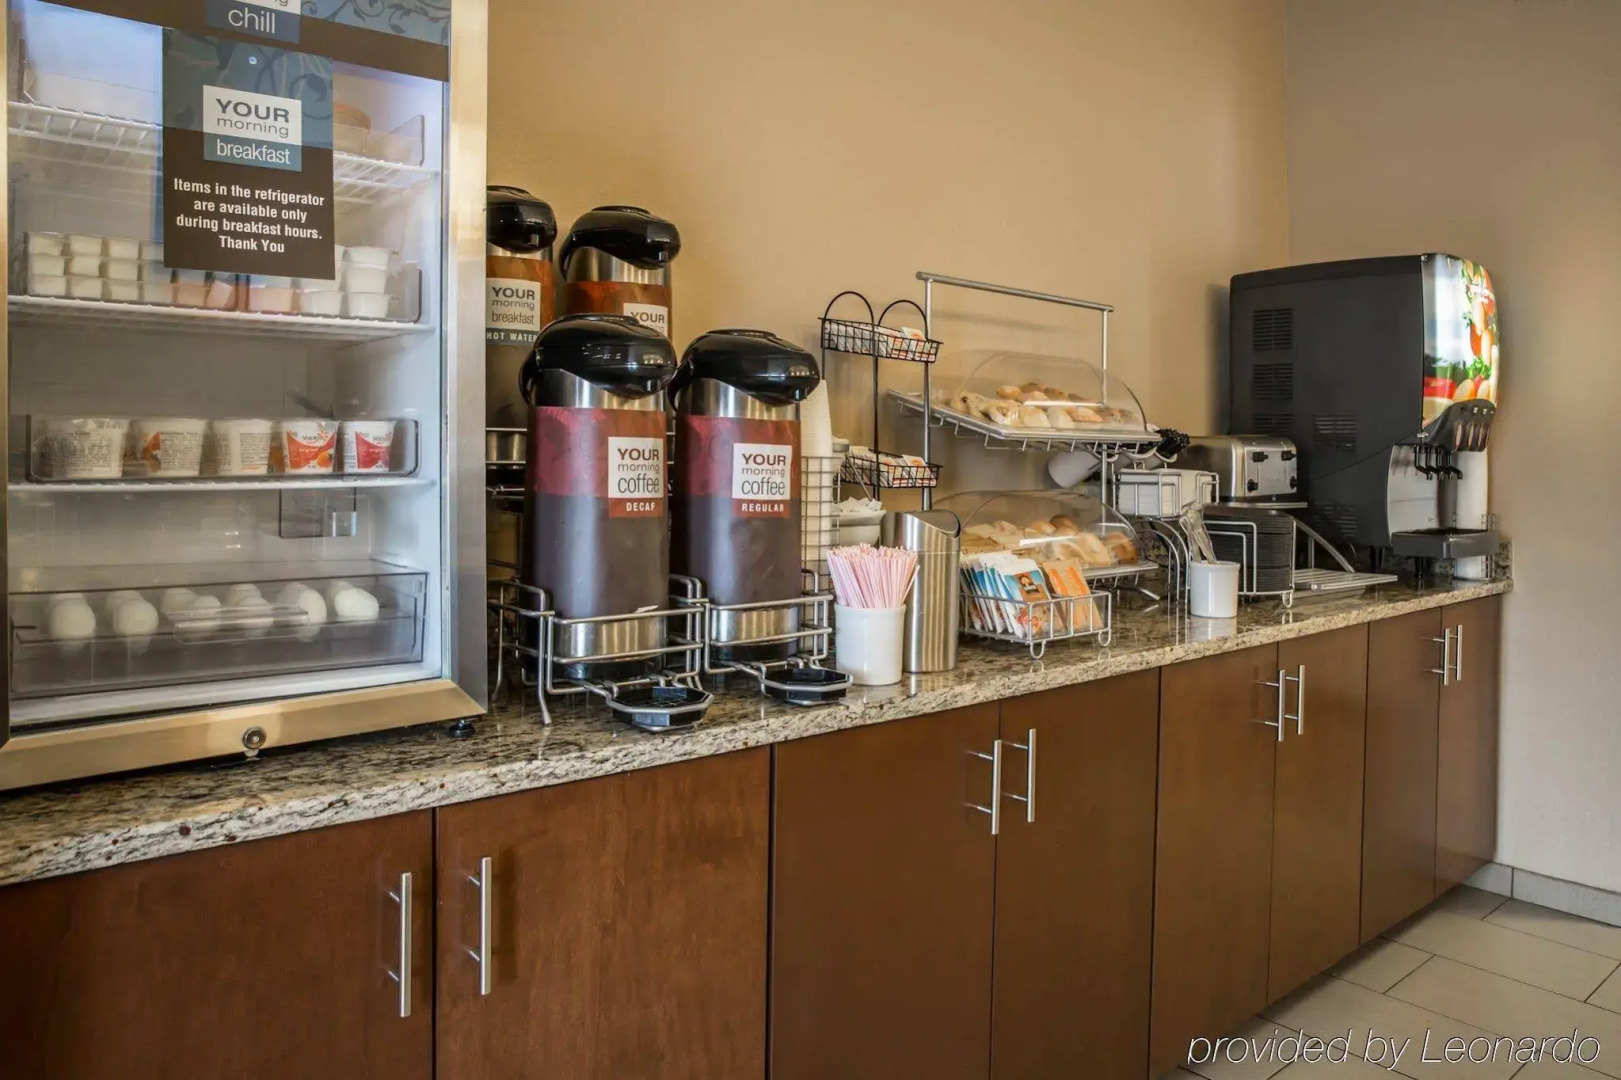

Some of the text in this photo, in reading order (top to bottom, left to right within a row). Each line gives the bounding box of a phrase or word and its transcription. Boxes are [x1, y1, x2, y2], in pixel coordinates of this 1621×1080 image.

[228, 7, 275, 34] chill
[216, 98, 290, 123] YOUR
[217, 117, 289, 139] morning
[217, 138, 290, 165] breakfast
[174, 178, 325, 206] Items in the refrigerator
[194, 200, 307, 223] are available only
[176, 214, 323, 240] during breakfast hours.
[219, 235, 285, 253] Thank You
[492, 286, 535, 301] YOUR
[491, 300, 535, 312] morning
[491, 311, 535, 325] breakfast
[630, 311, 665, 324] YOUR
[486, 331, 505, 341] HOT
[617, 448, 660, 461] YOUR
[742, 453, 786, 466] YOUR
[617, 463, 660, 476] morning
[741, 467, 786, 477] morning
[617, 473, 660, 494] coffee
[741, 477, 786, 496] coffee
[626, 502, 656, 512] DECAF
[741, 503, 784, 512] REGULAR
